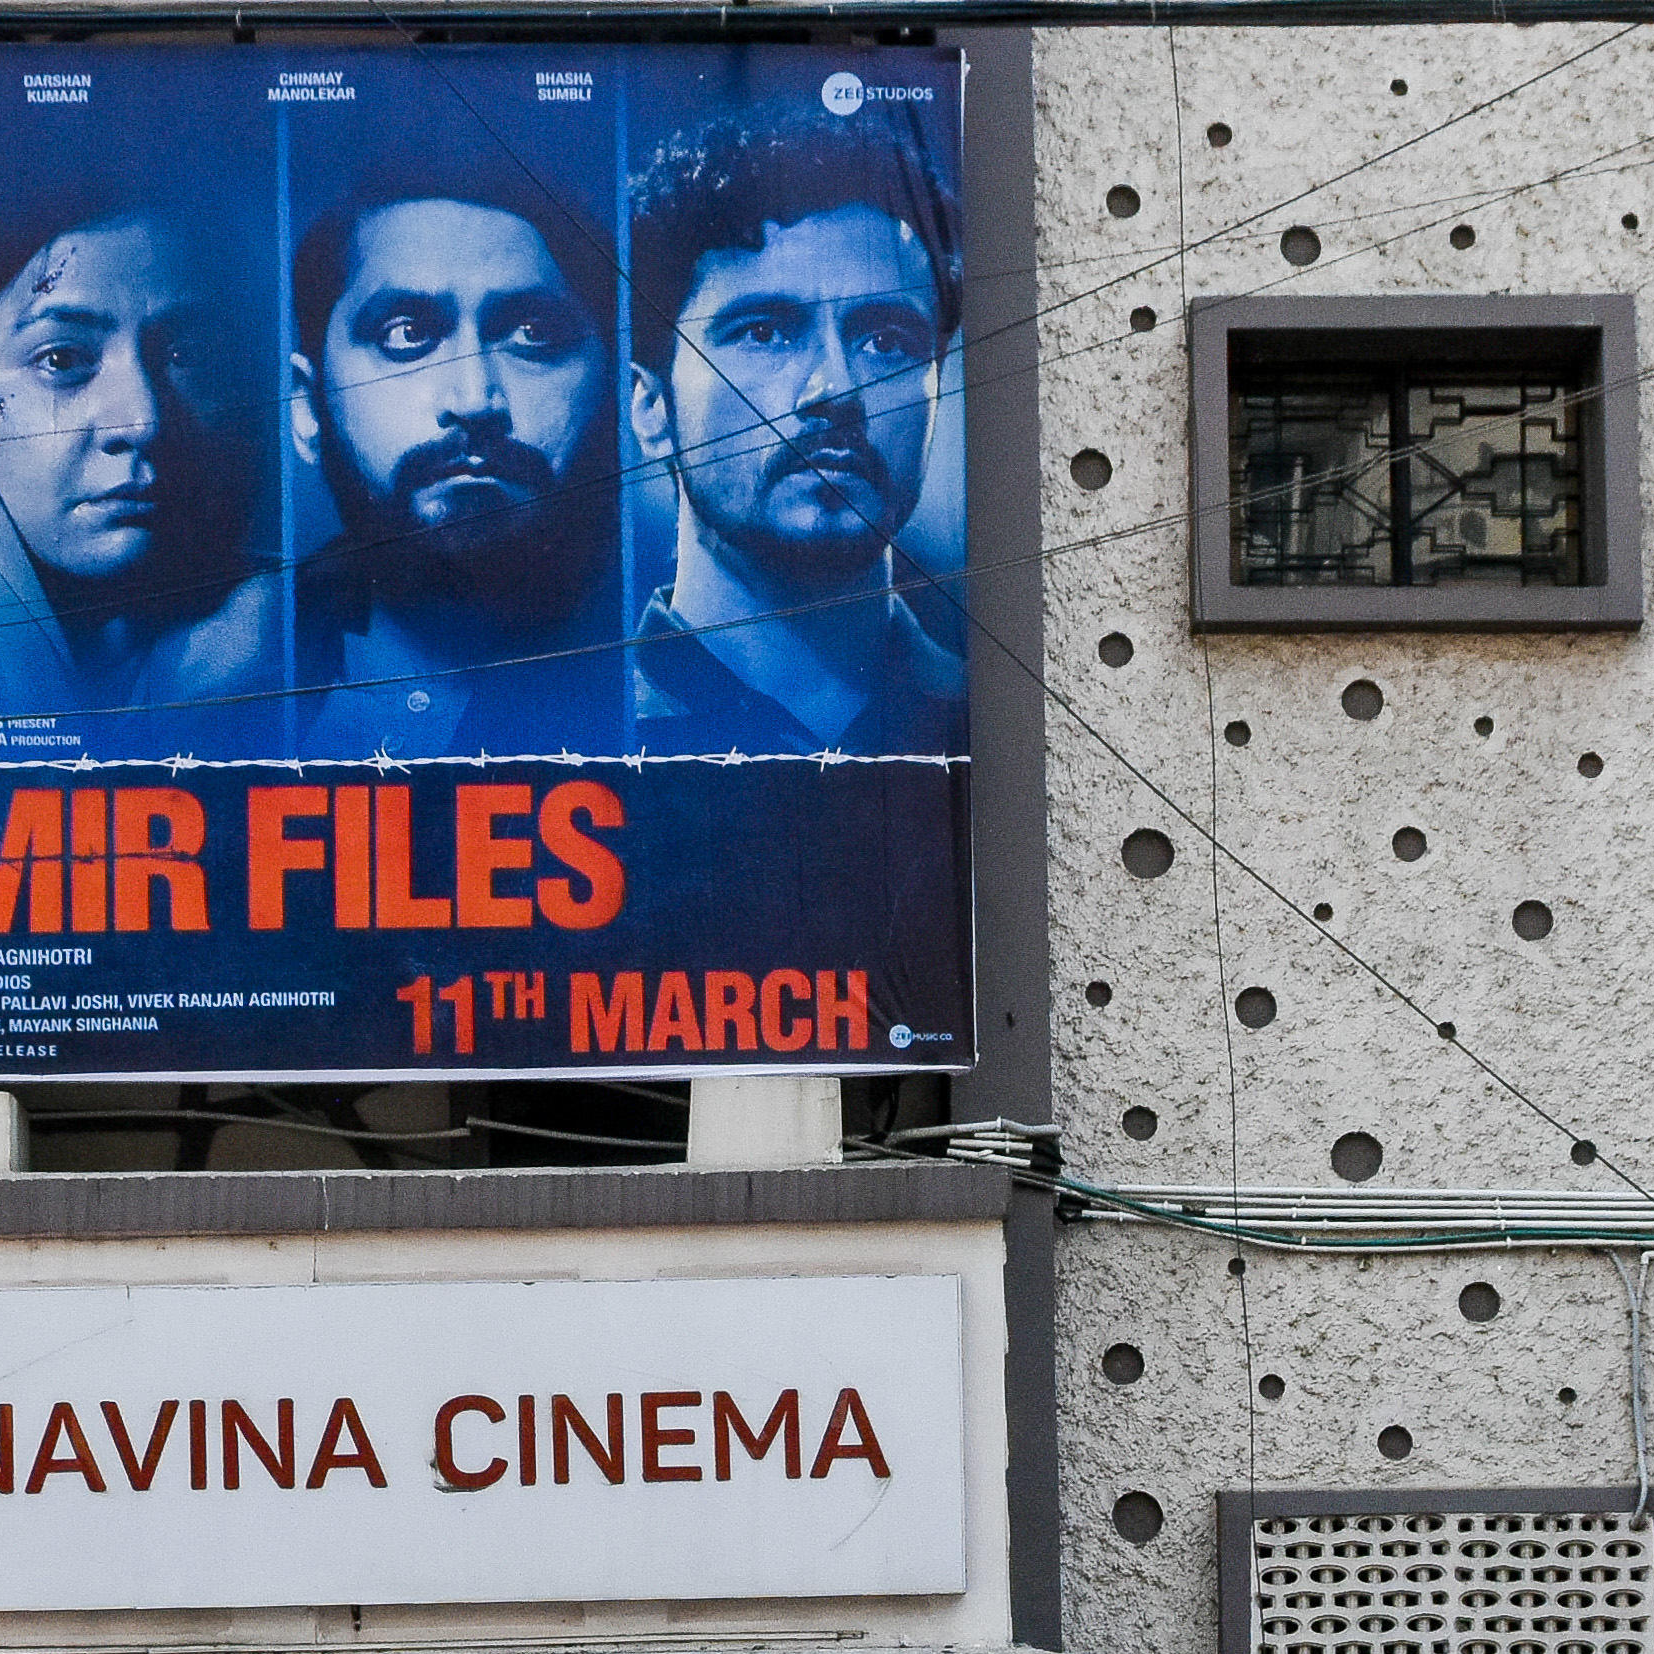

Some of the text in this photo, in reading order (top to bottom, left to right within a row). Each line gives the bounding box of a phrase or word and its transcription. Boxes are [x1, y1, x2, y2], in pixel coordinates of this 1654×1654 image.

[24, 74, 91, 87] DARSHAN
[279, 72, 343, 86] CHINMAY
[536, 72, 593, 85] BHASHA
[27, 89, 88, 102] KUMAAR
[268, 87, 355, 101] MANDLEKAR
[538, 88, 591, 101] SUMBLI
[248, 781, 624, 930] FILES
[1, 996, 67, 1011] PALLAVI
[71, 994, 123, 1012] JOSHI,
[127, 993, 174, 1009] VIVEK
[179, 993, 244, 1008] RANJAN
[249, 991, 335, 1007] AGNIHOTRI
[570, 969, 868, 1052] MARCH
[430, 1388, 891, 1493] CINEMA
